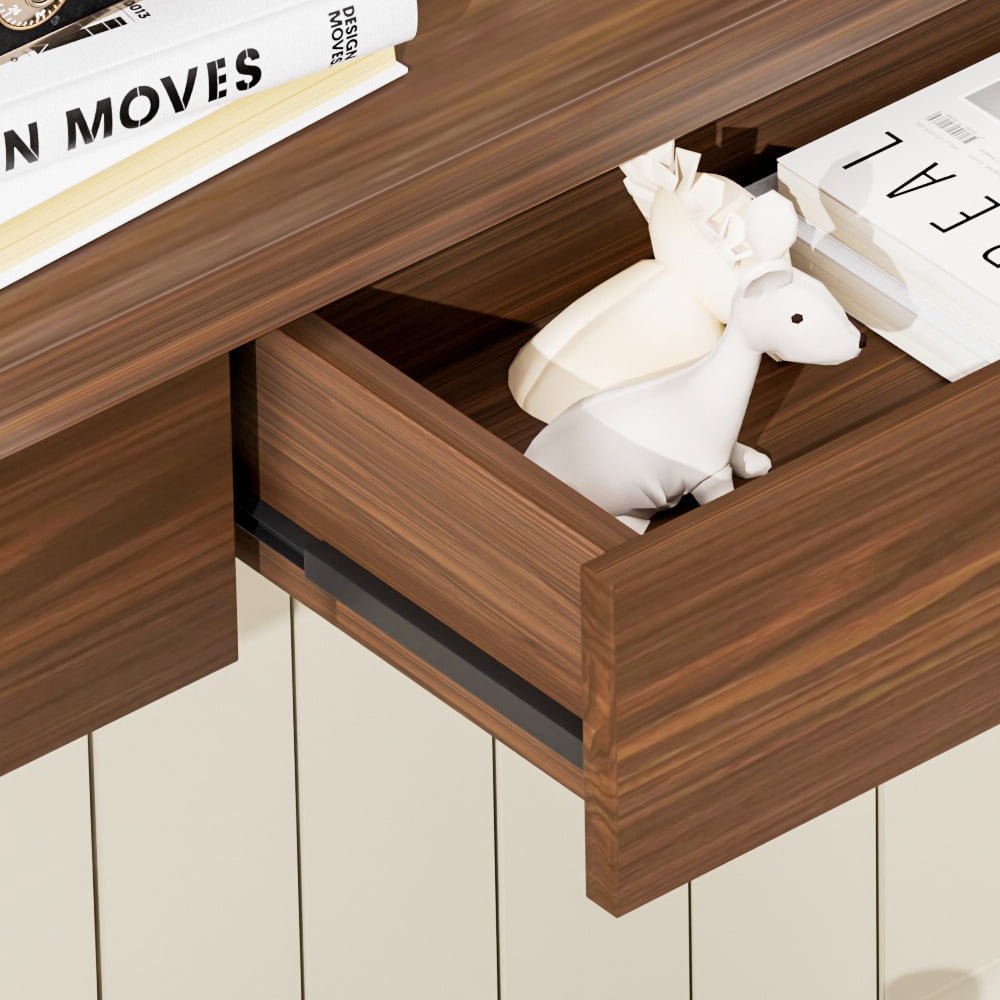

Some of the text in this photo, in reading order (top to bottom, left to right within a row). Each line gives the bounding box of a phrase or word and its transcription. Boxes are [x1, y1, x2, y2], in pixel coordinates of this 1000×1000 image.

[342, 5, 358, 60] DESIGN
[4, 48, 262, 171] N MOVES
